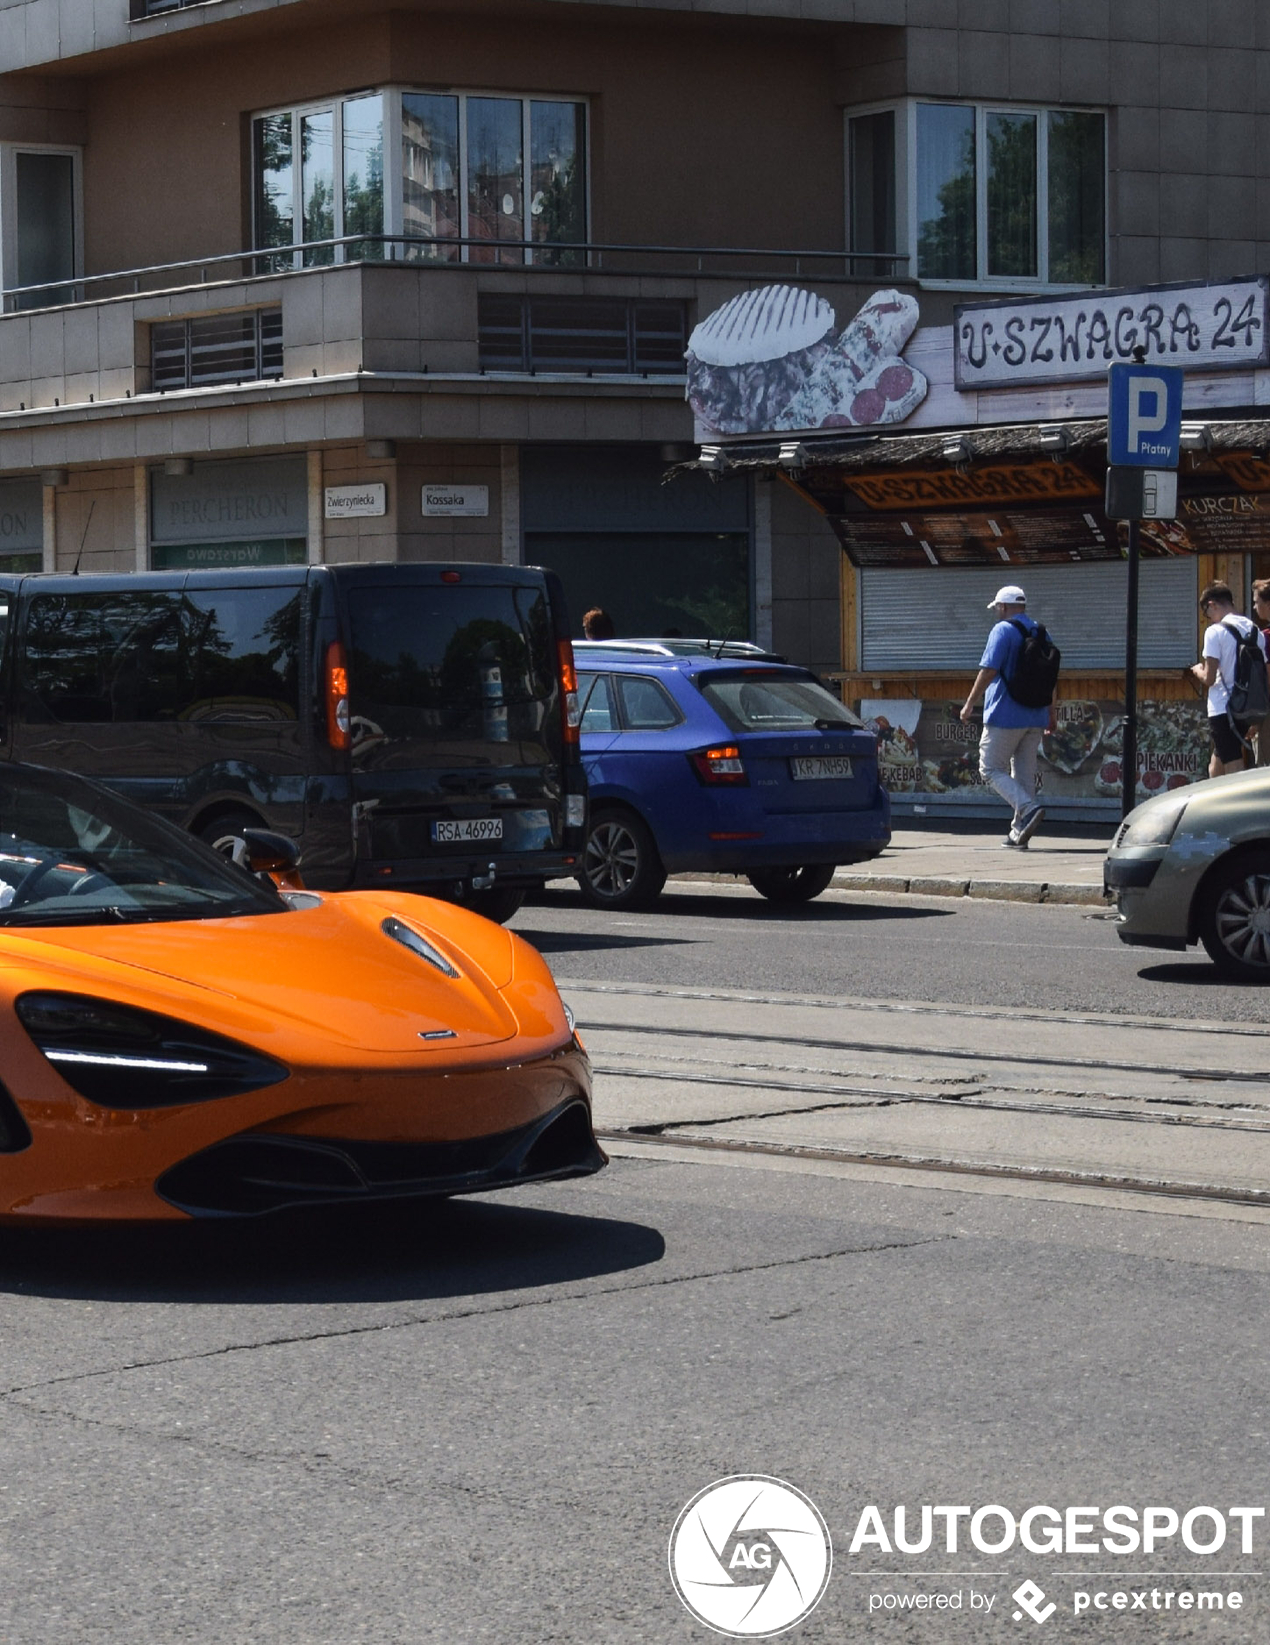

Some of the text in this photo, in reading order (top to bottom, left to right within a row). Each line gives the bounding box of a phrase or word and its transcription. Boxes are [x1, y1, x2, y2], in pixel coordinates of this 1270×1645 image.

[1211, 294, 1262, 351] 24
[1141, 442, 1171, 457] Płatny
[1040, 465, 1093, 492] 24
[169, 492, 288, 525] PERCHERON
[327, 493, 375, 509] Zwierzyniecka
[426, 493, 465, 506] Kossaka
[1181, 494, 1264, 516] KURCZAK
[935, 723, 978, 741] BURGER
[797, 758, 849, 775] KR 7NH59
[890, 766, 923, 782] KEBAB
[437, 820, 502, 840] RSA 46996
